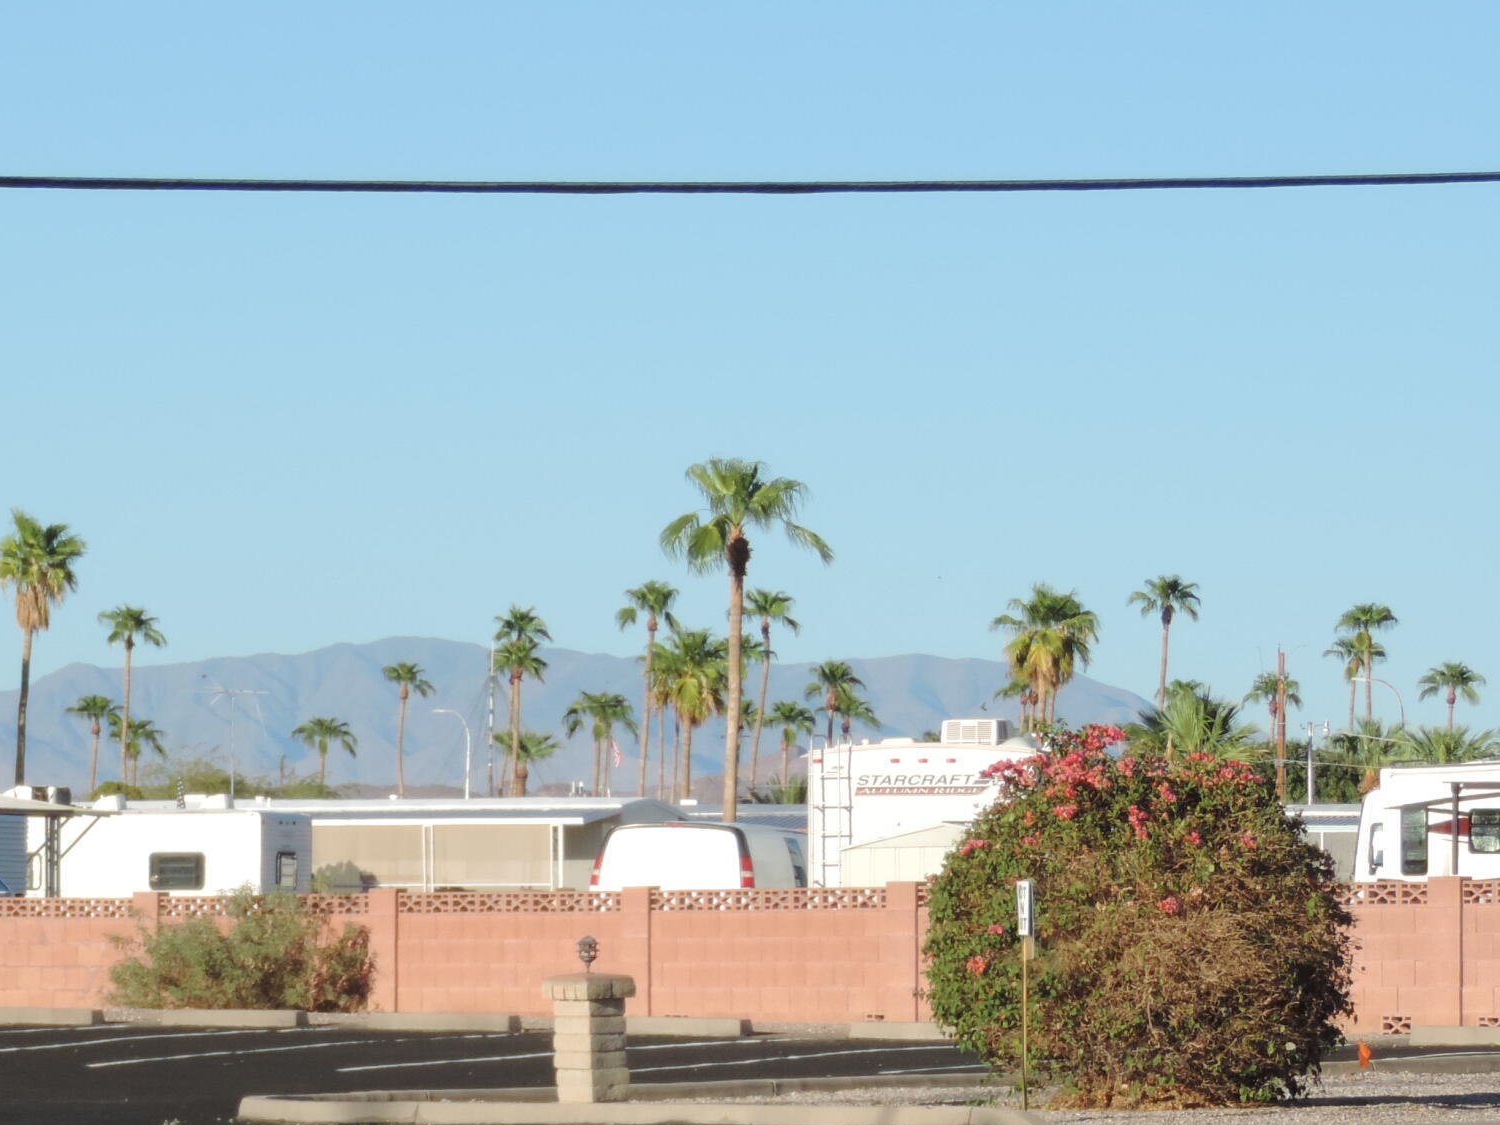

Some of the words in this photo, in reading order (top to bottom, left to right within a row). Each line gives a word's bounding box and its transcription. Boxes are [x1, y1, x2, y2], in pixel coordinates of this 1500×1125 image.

[856, 774, 974, 786] STARCRAFT
[858, 786, 930, 796] AUTUMN
[933, 786, 980, 796] RIDGE
